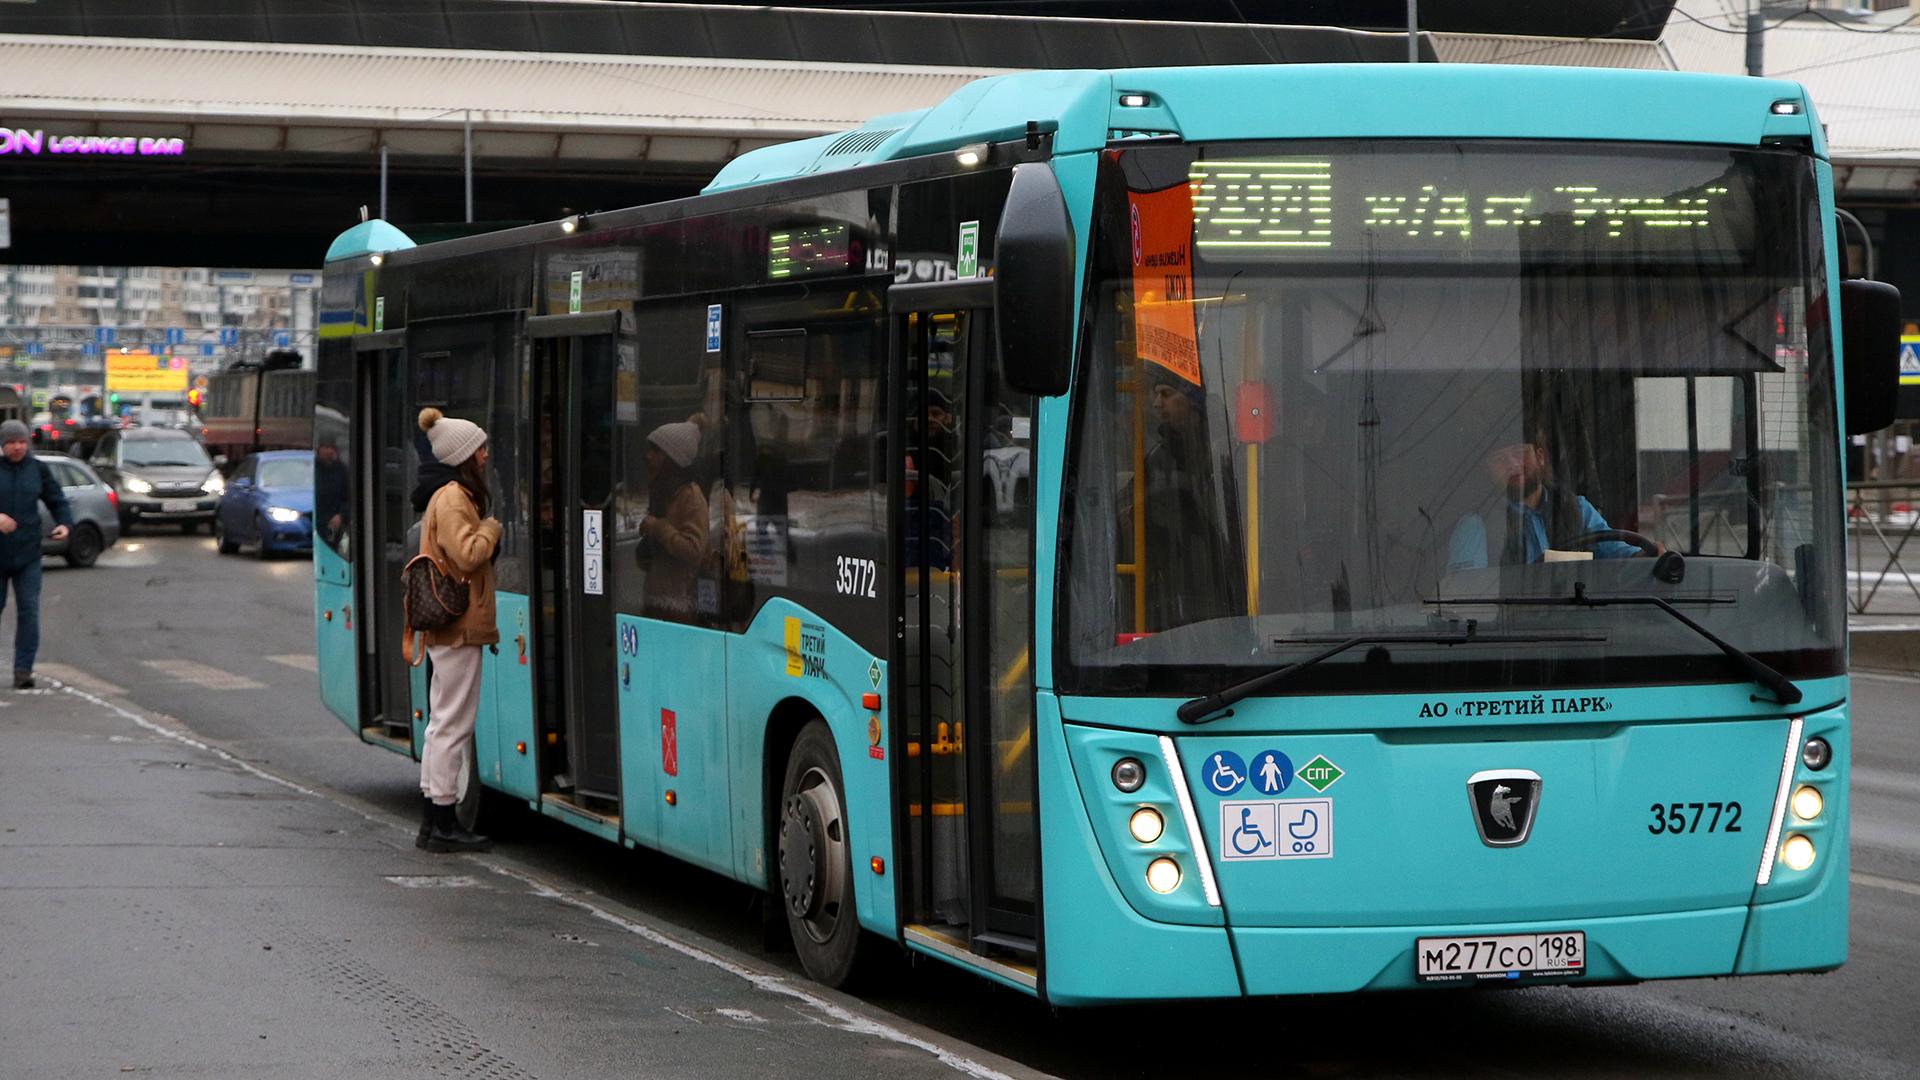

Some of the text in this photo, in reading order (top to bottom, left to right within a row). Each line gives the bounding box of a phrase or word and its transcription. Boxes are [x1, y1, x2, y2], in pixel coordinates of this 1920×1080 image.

[49, 136, 137, 154] LOUNGE
[139, 137, 185, 156] BAR
[836, 555, 876, 598] 35772
[801, 633, 826, 655] ТРЕТИЙ
[802, 654, 828, 680] ПАРК
[1419, 694, 1613, 718] АО «ТРЕТИЙ ПАРК»
[1306, 767, 1334, 780] СПГ
[1648, 801, 1743, 835] 35772
[1426, 936, 1578, 971] М277СО 198
[1547, 958, 1567, 967] RUS
